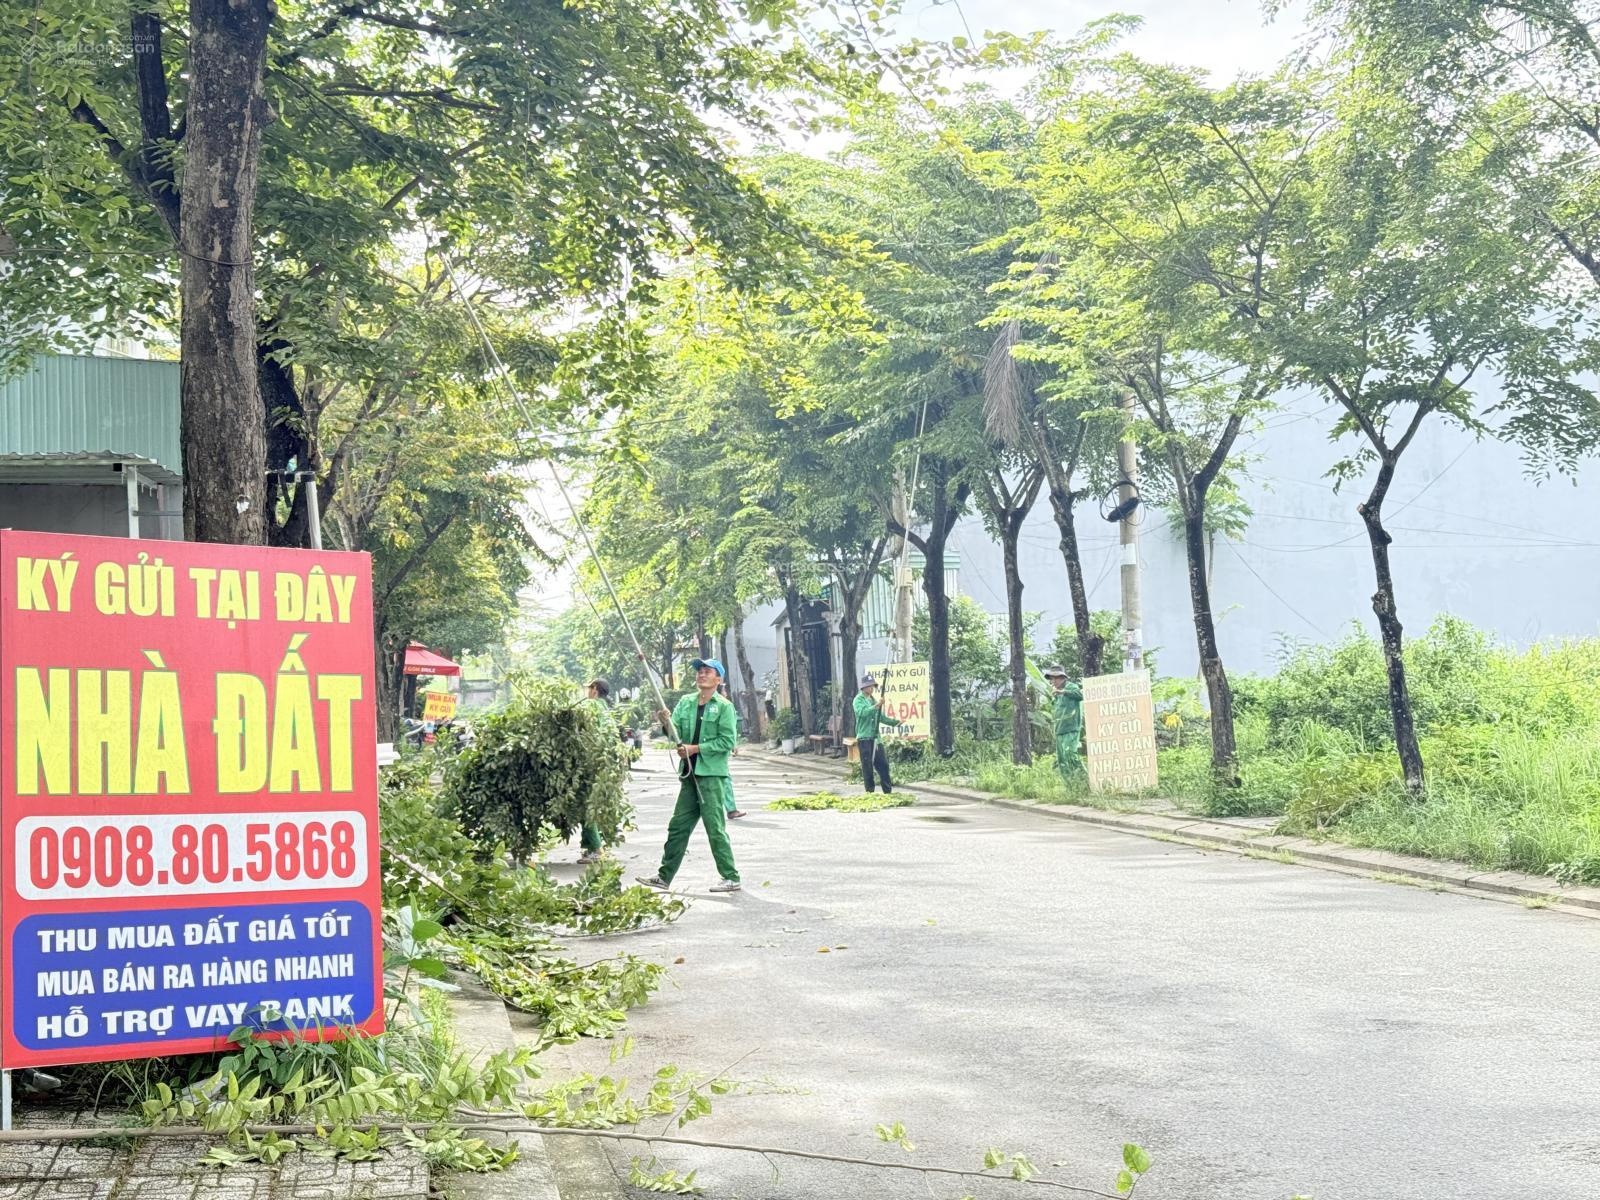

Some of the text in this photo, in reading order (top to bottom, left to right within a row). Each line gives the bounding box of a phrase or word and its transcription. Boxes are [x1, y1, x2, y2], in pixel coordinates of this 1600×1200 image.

[17, 551, 356, 629] KÝ GỬI TẠI ĐÂY
[15, 633, 363, 796] NHÀ ĐẤT
[899, 694, 926, 720] ĐẤT
[1090, 739, 1120, 756] MUA
[29, 820, 356, 890] 0908.80.5868
[37, 908, 352, 953] THU MUA ĐẤT GIÁ TỐT
[37, 953, 354, 998] MUA BÁN RA HÀNG NHANH
[37, 994, 355, 1040] HỖ TRỢ VAY BANK
